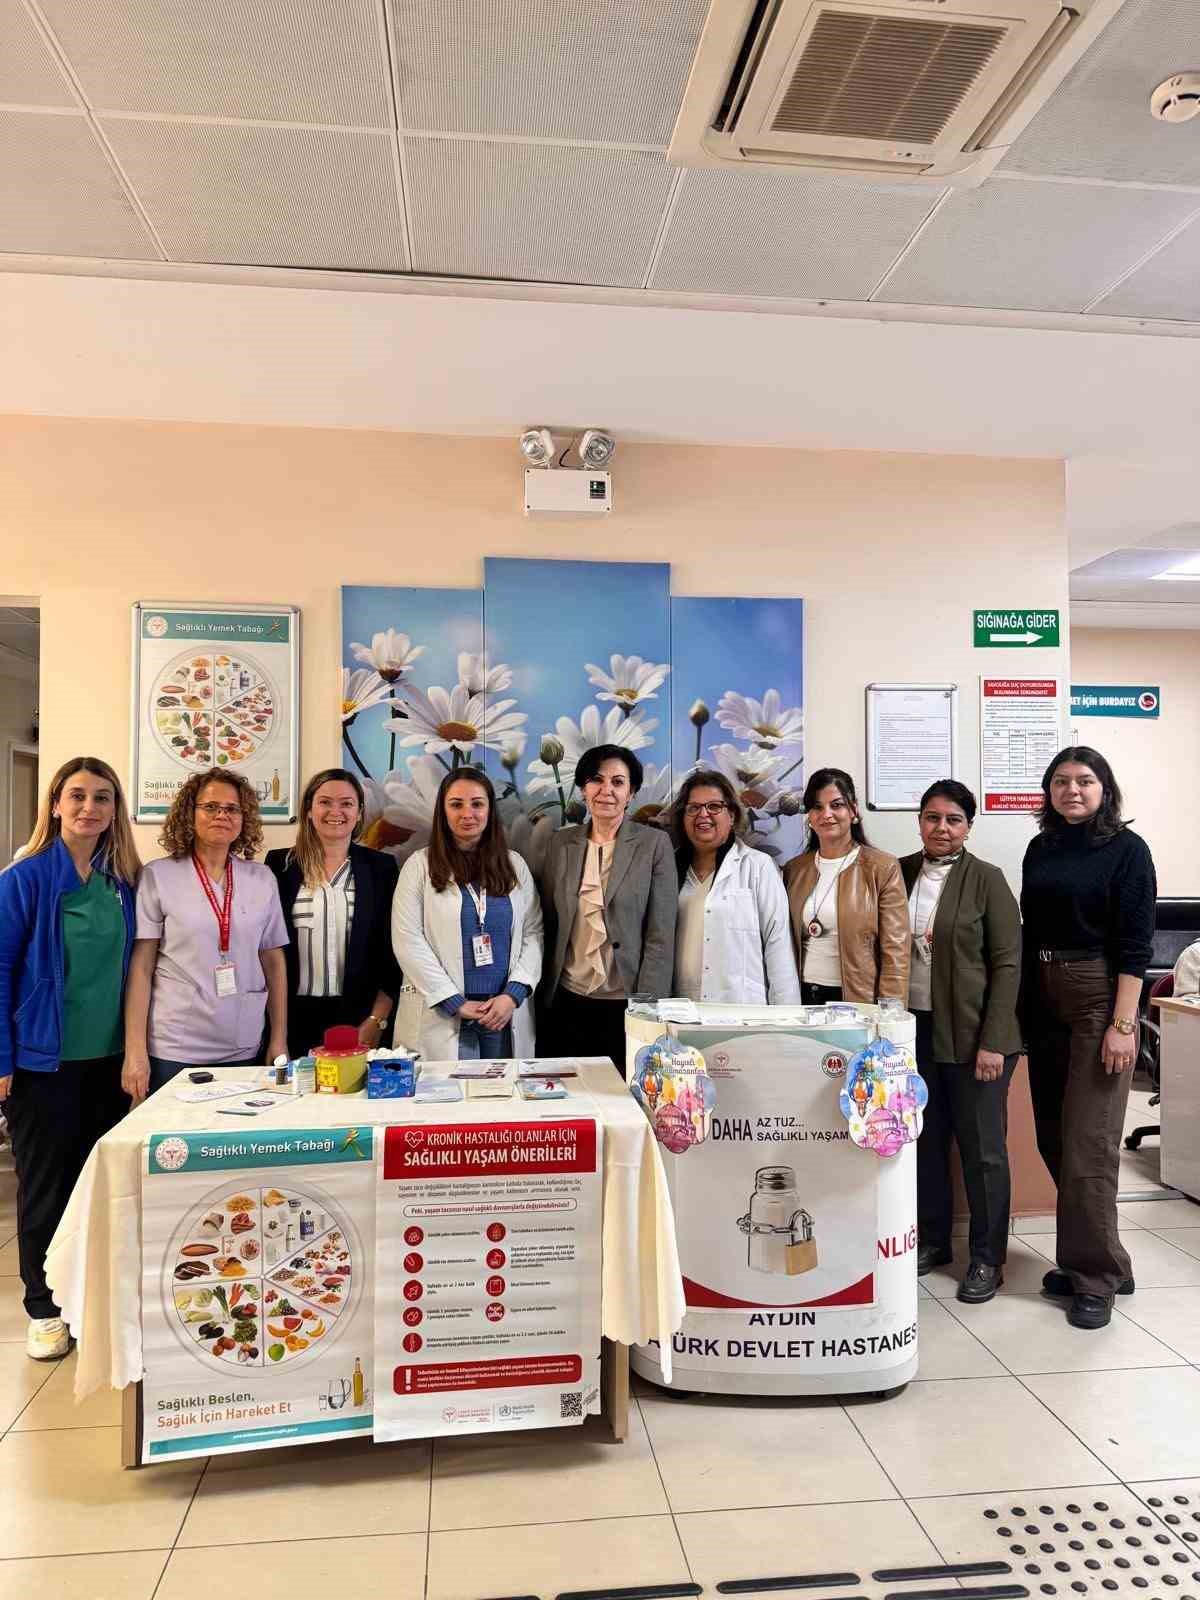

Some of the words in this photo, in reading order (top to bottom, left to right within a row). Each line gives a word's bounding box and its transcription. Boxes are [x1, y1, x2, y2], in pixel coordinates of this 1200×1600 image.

[976, 612, 1024, 628] SIĞINAĞA
[1026, 611, 1057, 628] GİDER
[175, 623, 206, 633] Sağlıklı
[209, 624, 235, 633] Yemek
[237, 625, 264, 635] Tabağı
[1082, 693, 1098, 708] İÇİN
[1099, 696, 1137, 706] BURDAYIZ
[711, 1118, 753, 1141] DAHA
[756, 1118, 772, 1127] AZ
[774, 1117, 805, 1127] TUZ...
[427, 1130, 463, 1146] KRONİK
[464, 1128, 513, 1144] HASTALIĞI
[514, 1128, 557, 1143] OLANLAR
[558, 1127, 577, 1143] İÇİN
[756, 1129, 808, 1141] SAĞLIKLI
[811, 1131, 849, 1142] YAŞAM
[200, 1143, 248, 1159] Sağlıklı
[250, 1142, 292, 1154] Yemek
[294, 1139, 336, 1154] Tabağı
[404, 1147, 461, 1167] SAĞLIKLI
[464, 1148, 508, 1168] YAŞAM
[510, 1143, 577, 1163] ÖNERİLERİ
[748, 1311, 816, 1326] AYDIN
[727, 1340, 815, 1358] DEVLET
[157, 1396, 205, 1412] Sağlıklı
[208, 1391, 255, 1406] Beslen,
[157, 1411, 196, 1429] Sağlık
[200, 1409, 222, 1425] İçin
[225, 1405, 276, 1421] Hareket
[279, 1402, 292, 1414] Et
